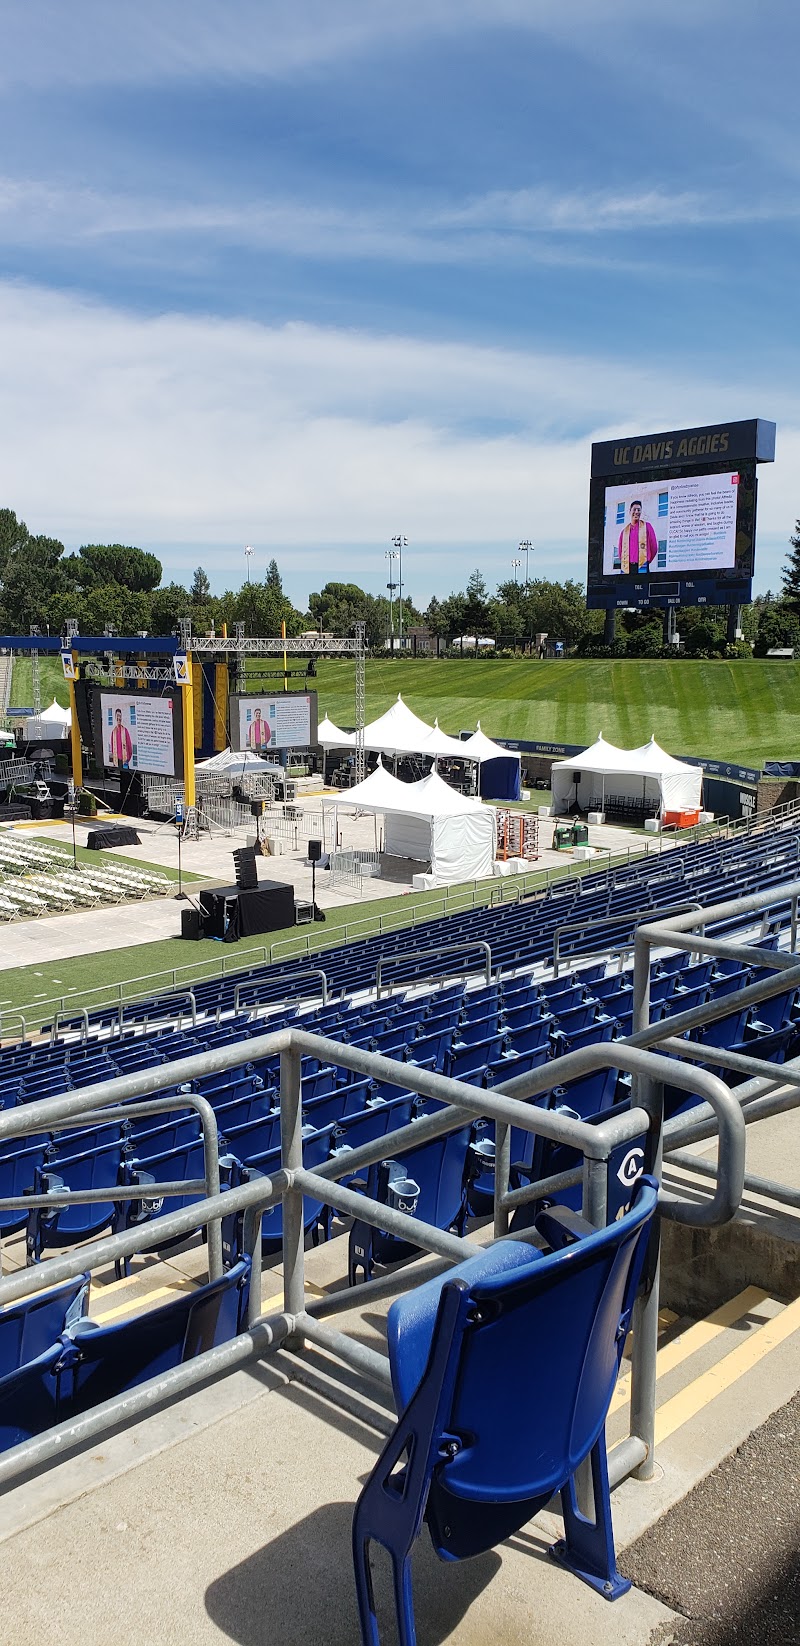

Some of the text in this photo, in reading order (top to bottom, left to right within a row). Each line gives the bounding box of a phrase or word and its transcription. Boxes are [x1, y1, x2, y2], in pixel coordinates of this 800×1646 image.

[614, 432, 730, 466] UC DAVIS AGGIES
